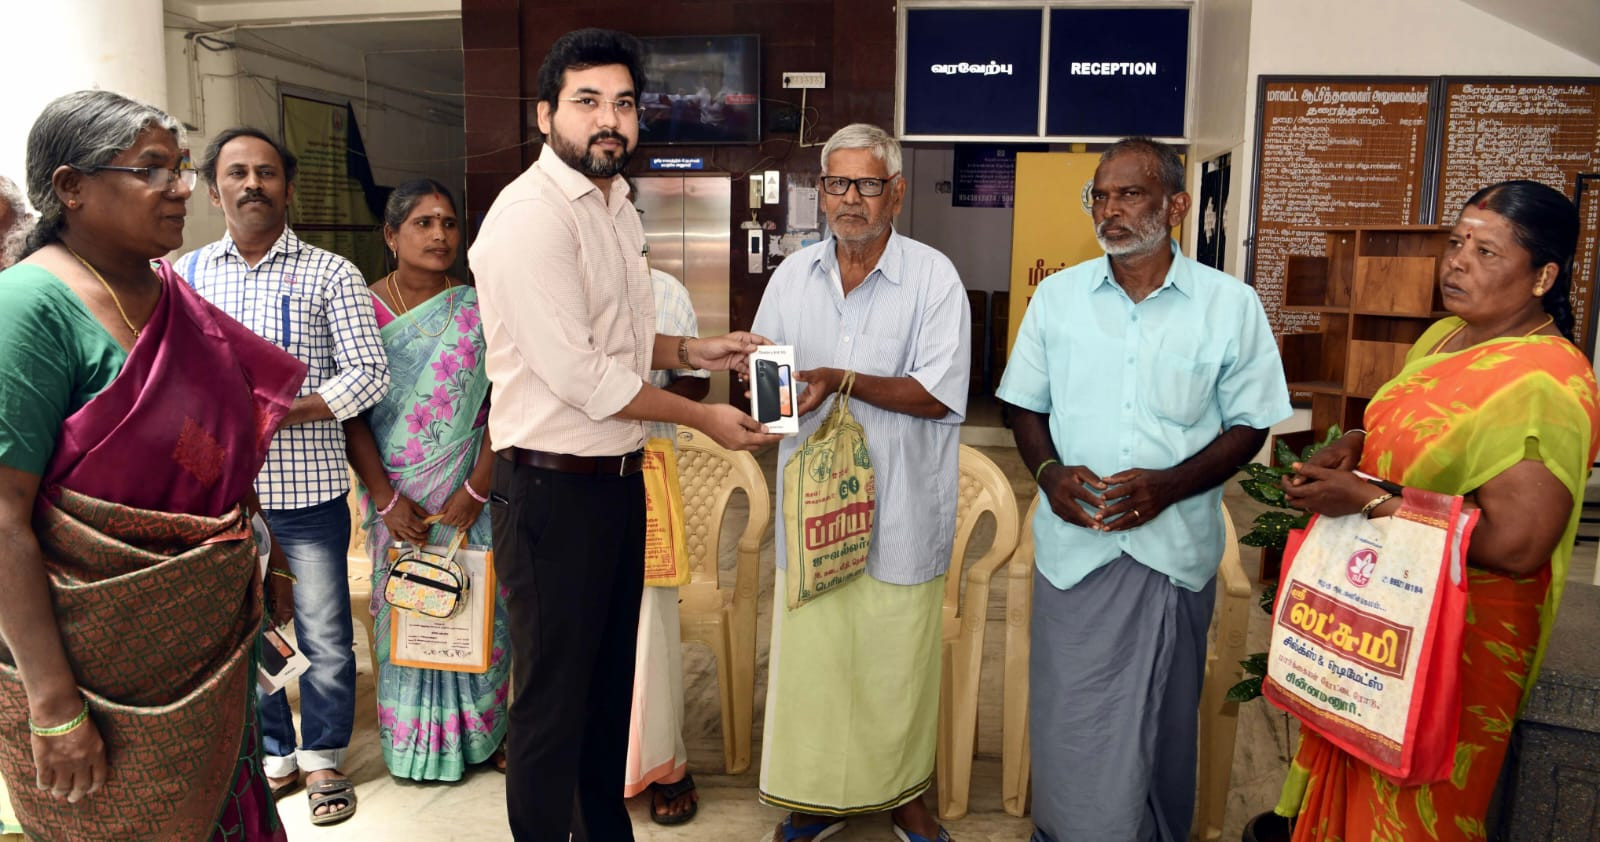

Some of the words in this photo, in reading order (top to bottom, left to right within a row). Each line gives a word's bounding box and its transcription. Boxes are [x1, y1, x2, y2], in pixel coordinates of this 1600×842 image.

[931, 60, 1013, 76] வரவேற்பு
[1070, 62, 1157, 75] RECEPTION
[1267, 87, 1299, 102] மாவட்ட
[1301, 85, 1371, 104] ஆட்சித்தலைவர்
[1462, 84, 1517, 95] இரண்டாம்
[1518, 85, 1545, 95] தளம்
[1306, 104, 1379, 118] தரைத்தளம்
[812, 536, 870, 568] ஜுவல்லர்
[1291, 586, 1306, 601] ஸ்ரீ
[1290, 602, 1399, 668] லட்சுமி
[1283, 635, 1317, 666] சில்க்ஸ்
[1317, 656, 1324, 666] &
[1328, 660, 1384, 691] ரெடிமேட்ஸ்
